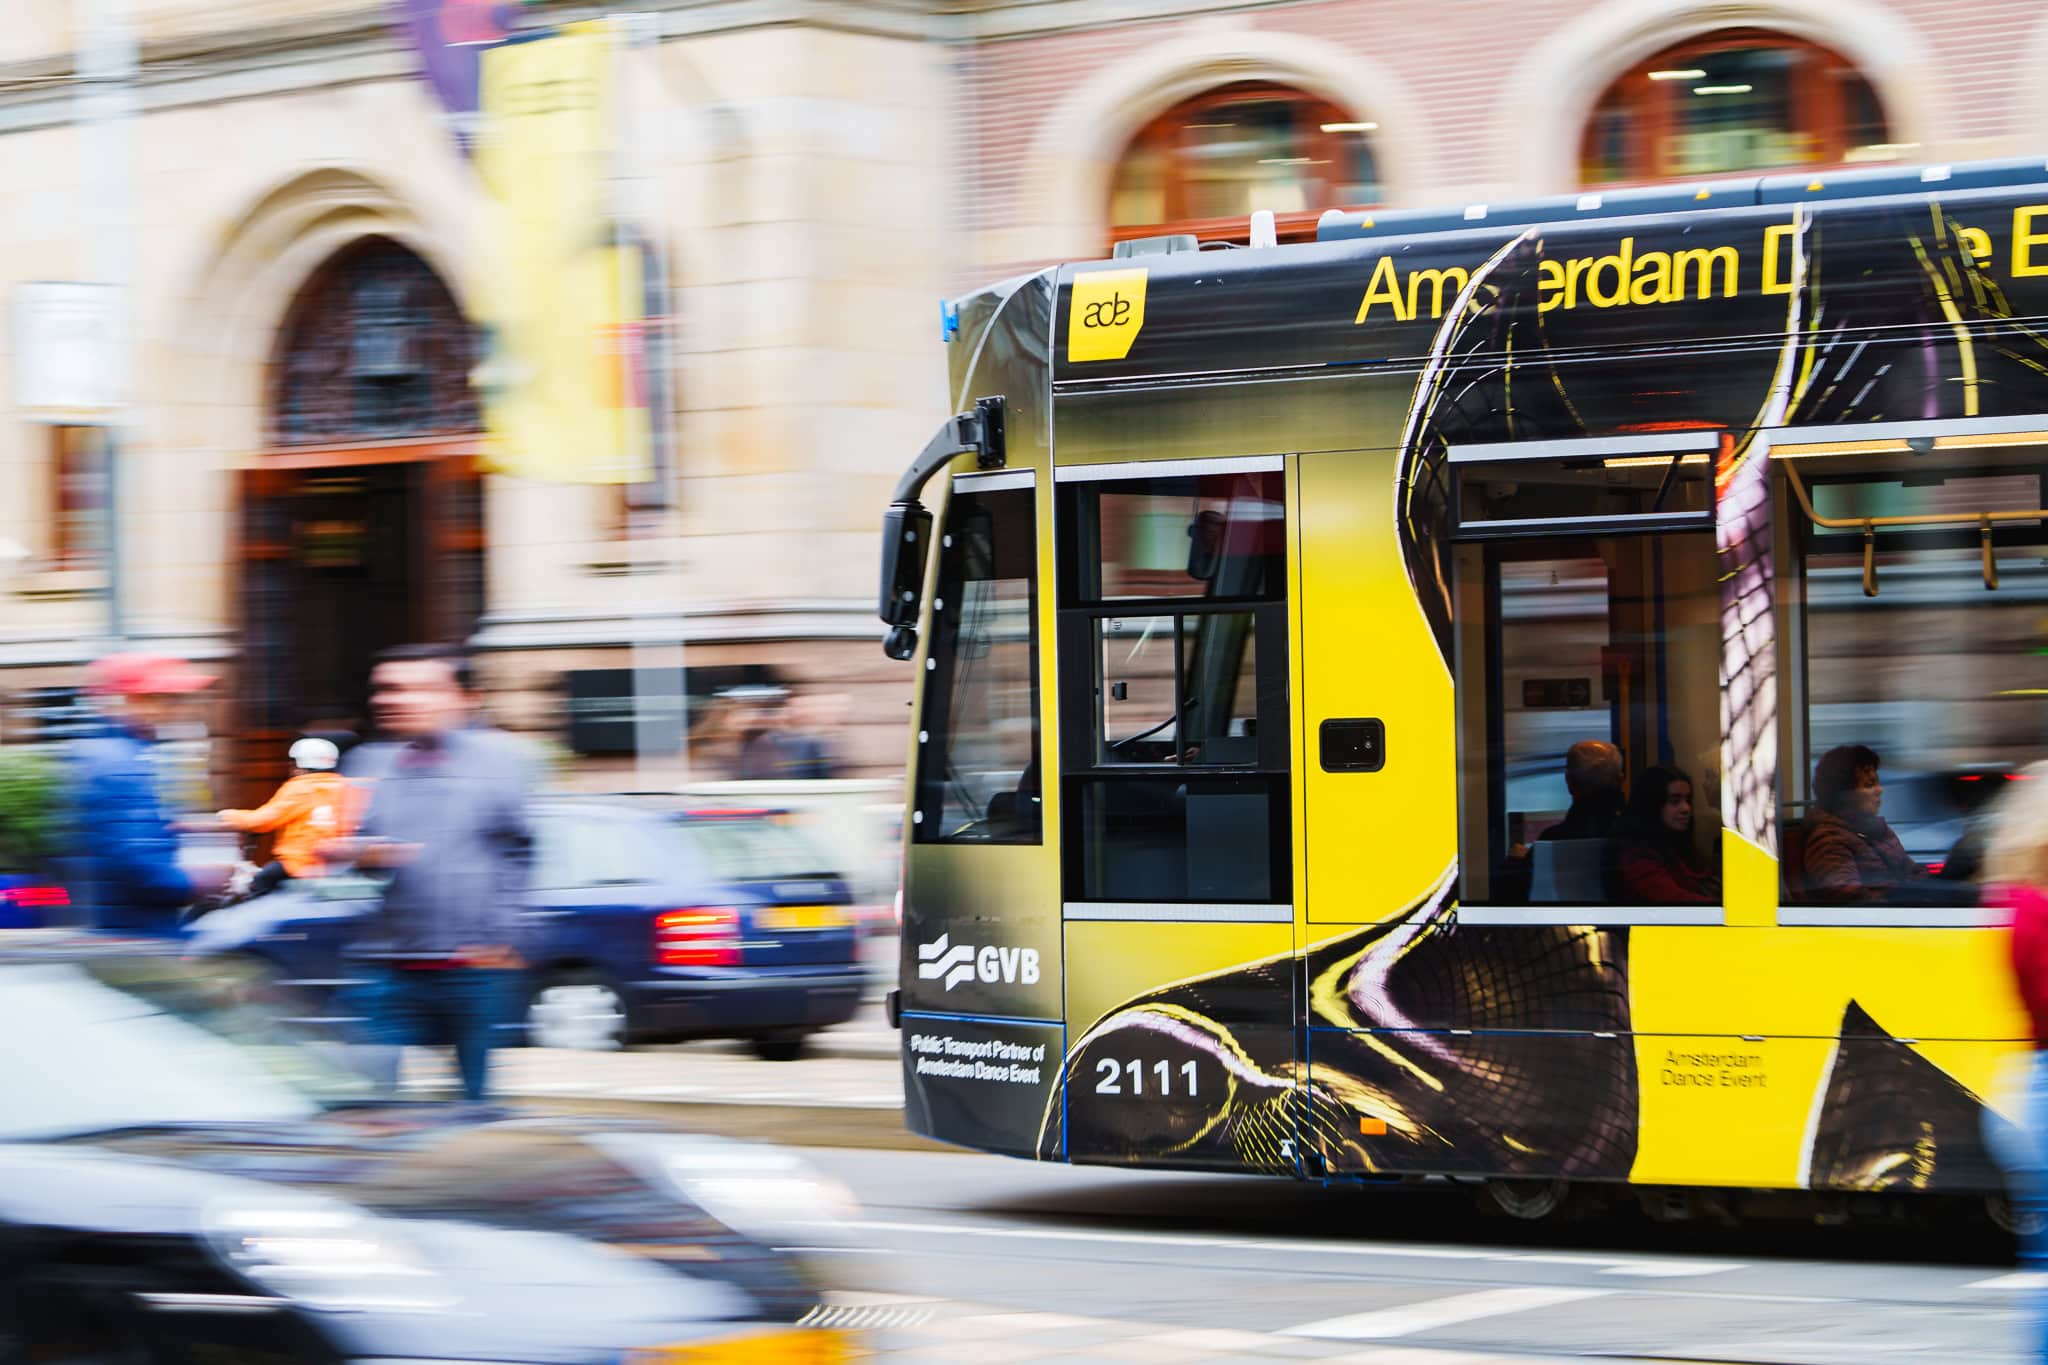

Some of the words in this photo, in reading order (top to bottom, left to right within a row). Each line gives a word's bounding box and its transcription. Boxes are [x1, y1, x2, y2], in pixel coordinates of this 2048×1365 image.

[1354, 236, 1740, 325] Amerdam
[1083, 291, 1131, 328] ade
[976, 945, 1040, 985] GVB
[910, 1033, 944, 1054] Public
[992, 1040, 1032, 1061] Partner
[1032, 1043, 1046, 1062] of
[1665, 1050, 1762, 1068] Amsterdam
[974, 1060, 1009, 1081] Dance
[1009, 1063, 1041, 1084] Event
[1095, 1058, 1198, 1096] 2111
[1661, 1068, 1713, 1087] Dance
[1720, 1069, 1767, 1088] Event
